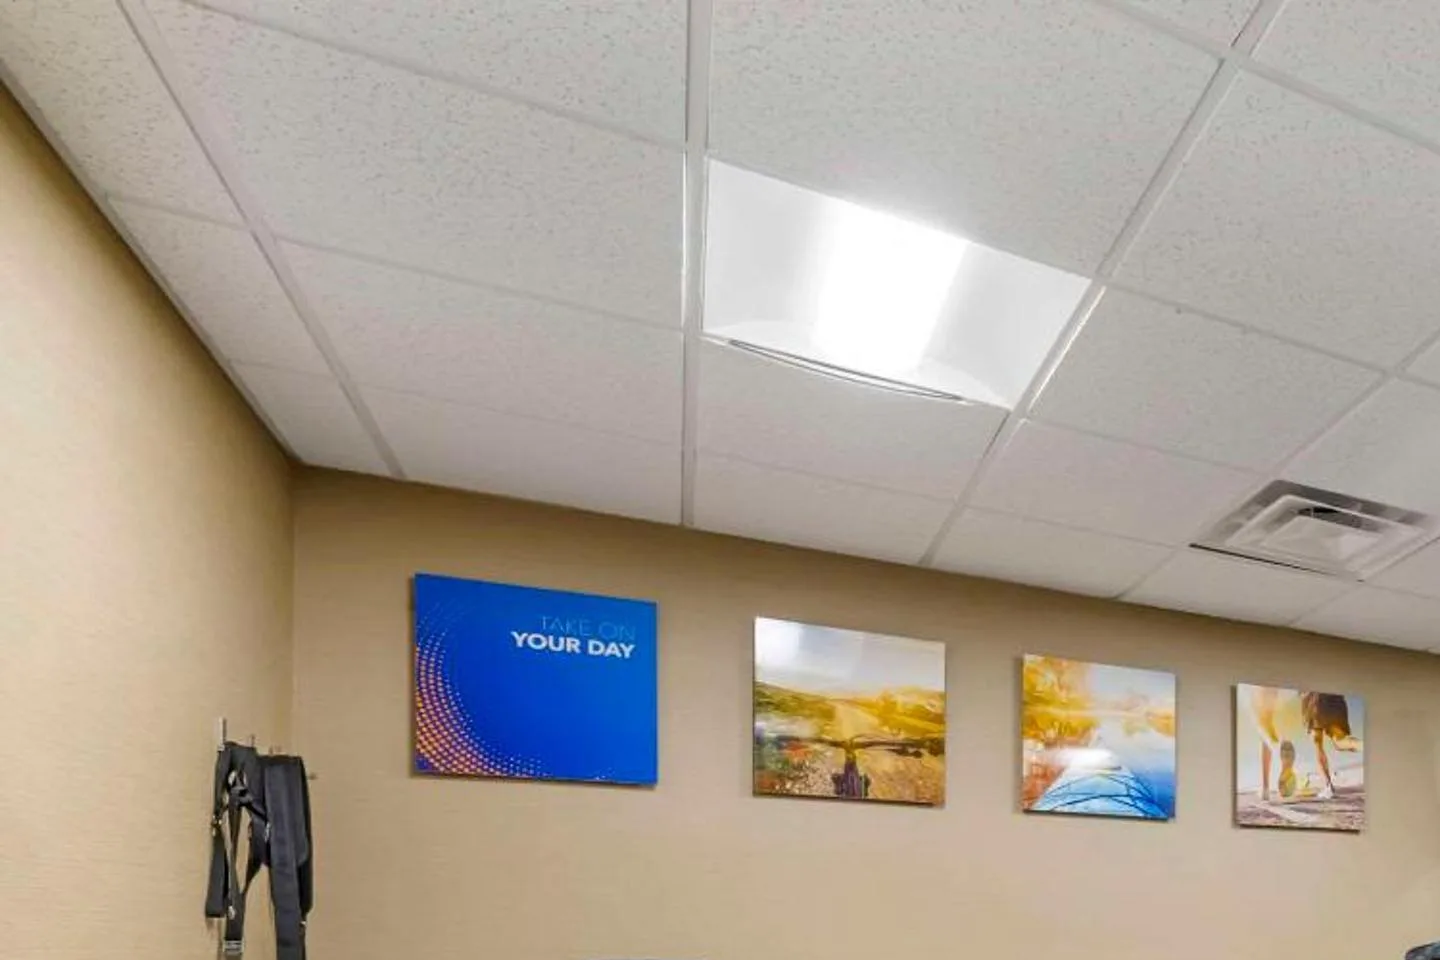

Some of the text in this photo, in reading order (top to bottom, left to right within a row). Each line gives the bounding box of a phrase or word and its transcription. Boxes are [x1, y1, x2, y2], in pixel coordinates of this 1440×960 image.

[540, 615, 636, 641] TAKE ON
[511, 631, 635, 659] YOUR DAY
